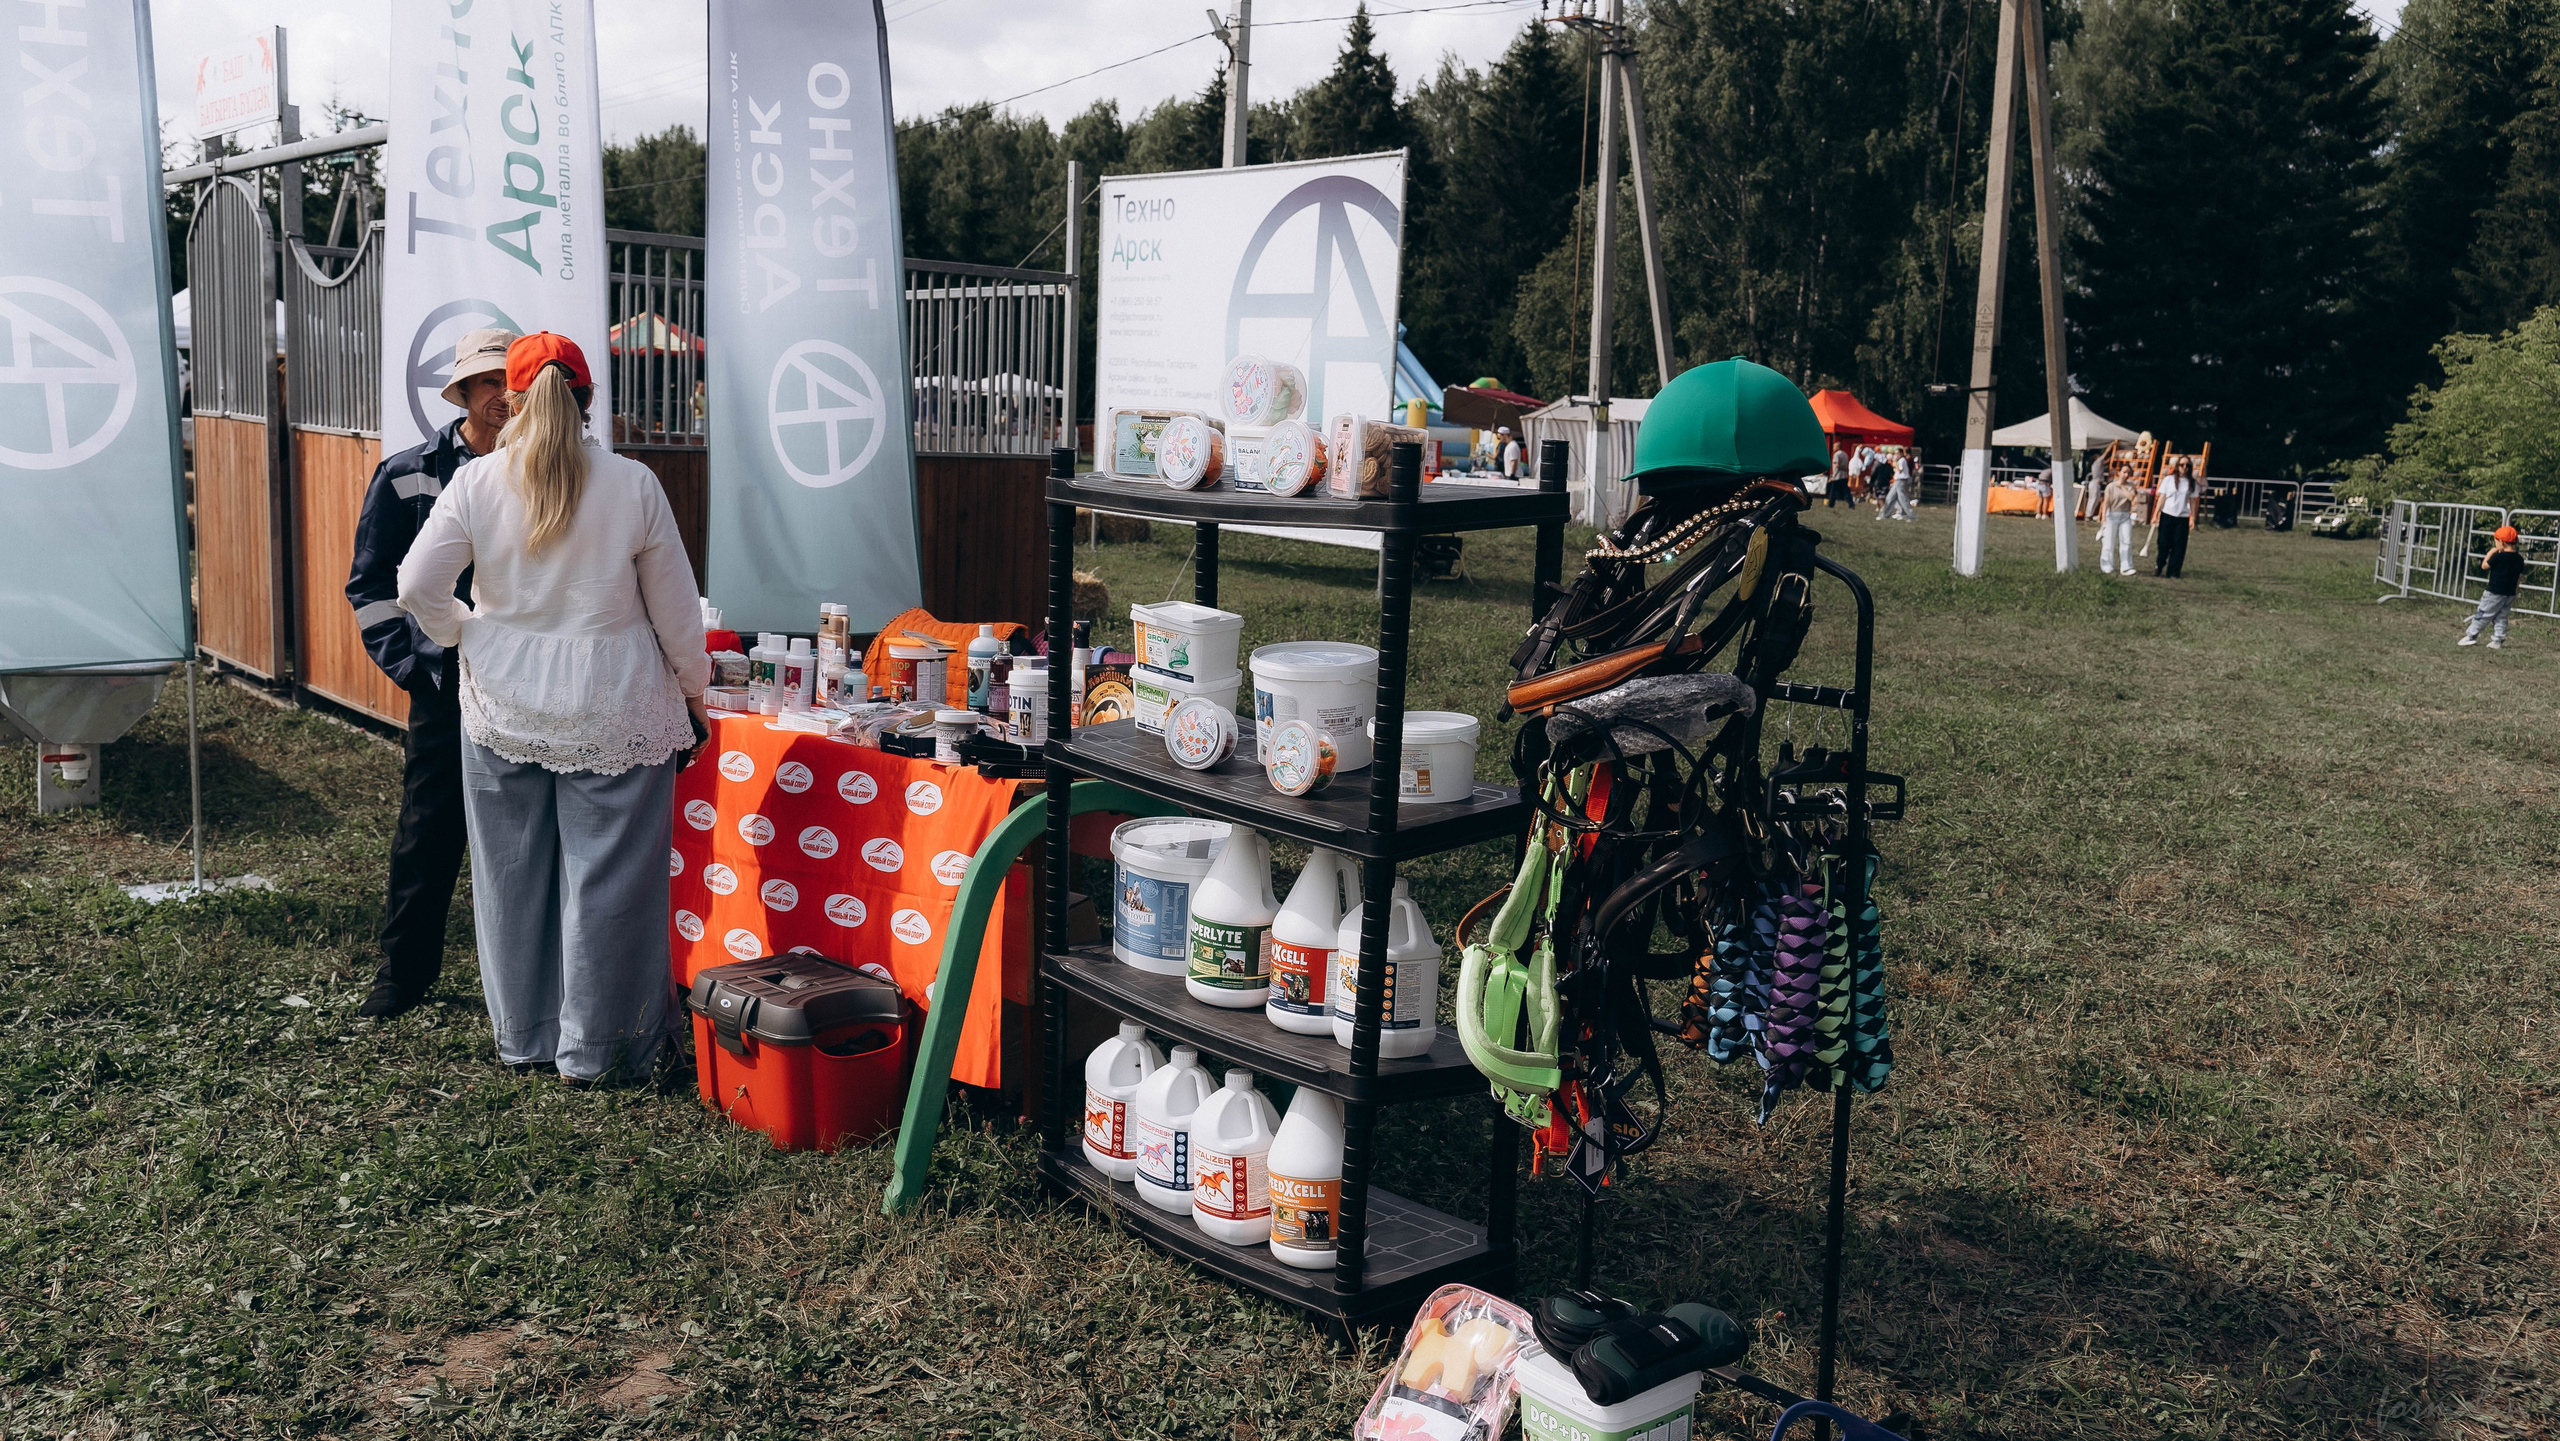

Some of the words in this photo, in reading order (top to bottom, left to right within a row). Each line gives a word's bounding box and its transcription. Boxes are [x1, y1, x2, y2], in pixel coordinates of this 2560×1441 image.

[549, 2, 566, 46] АПК
[553, 51, 570, 108] благо
[558, 113, 570, 138] во
[485, 30, 558, 277] Арск
[557, 141, 573, 232] металла
[1113, 193, 1175, 224] Техно
[559, 236, 575, 281] Сила
[1111, 233, 1162, 271] Арск
[1147, 633, 1170, 644] GROW
[1137, 691, 1164, 703] JUNIOR
[951, 871, 965, 879] СПО
